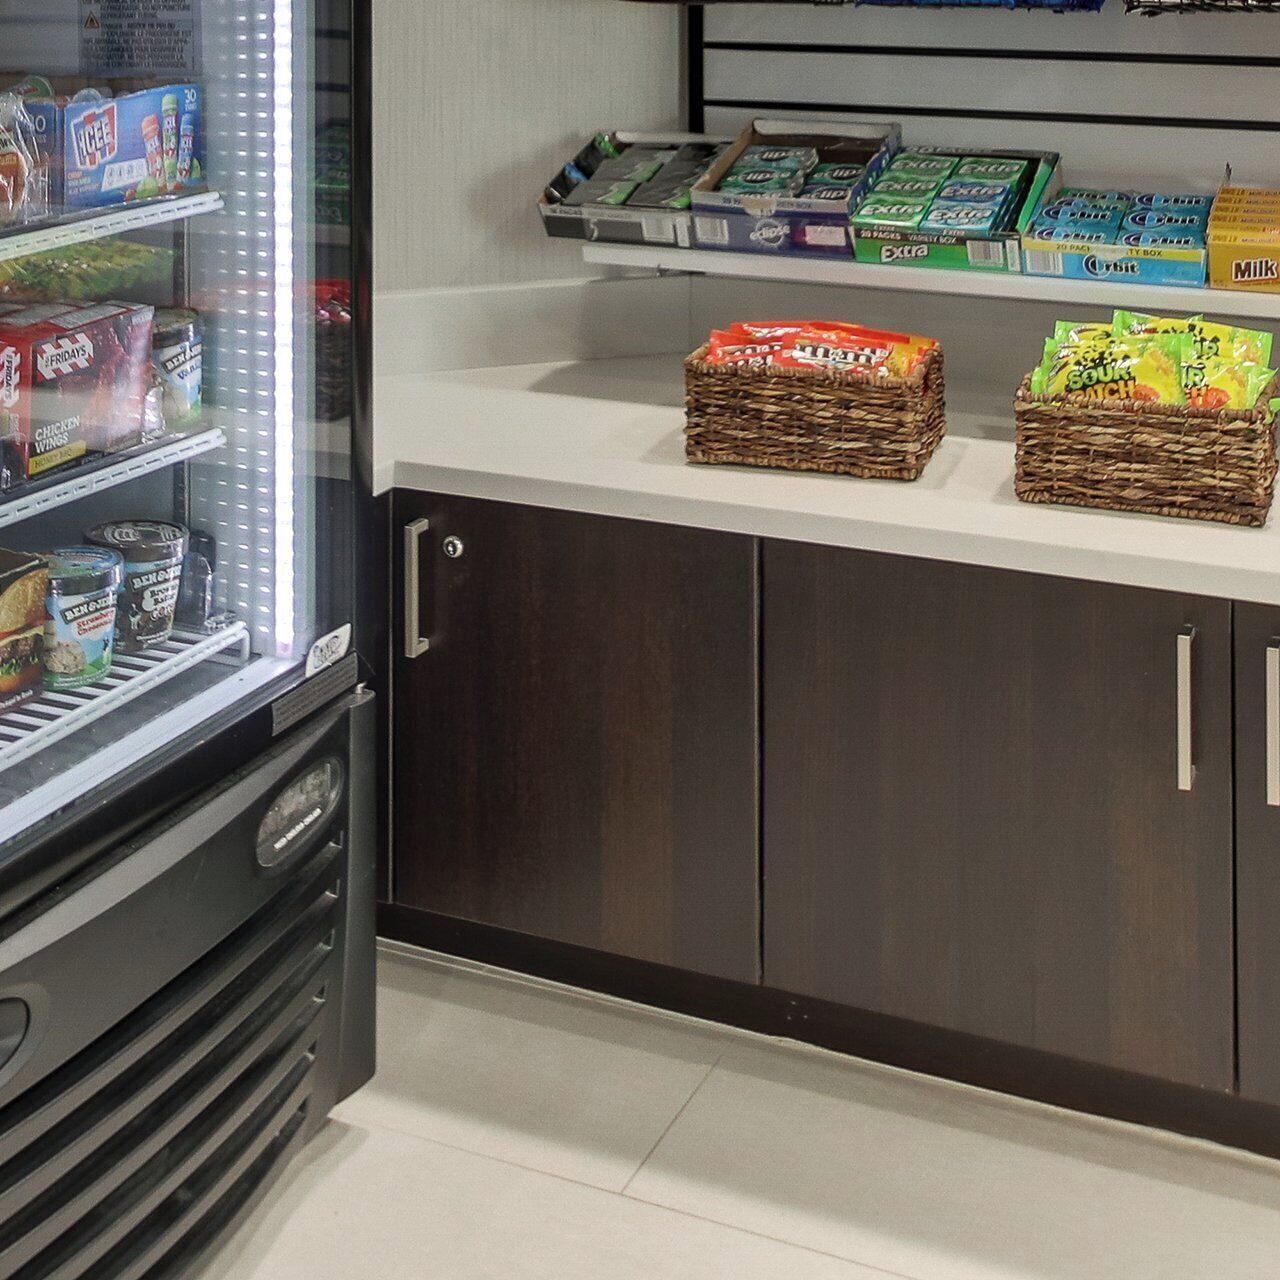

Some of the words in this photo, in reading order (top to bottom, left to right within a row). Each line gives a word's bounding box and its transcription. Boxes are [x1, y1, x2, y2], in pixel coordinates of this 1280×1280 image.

[184, 88, 197, 104] 30
[874, 180, 937, 191] Extra
[940, 185, 1004, 197] Extra
[859, 203, 924, 215] Extra
[926, 208, 993, 220] Extra
[750, 223, 791, 241] eclipse
[880, 243, 929, 263] Extra
[1142, 249, 1163, 257] BOX
[1082, 254, 1140, 279] Orbit
[1232, 257, 1276, 282] Milk
[50, 344, 87, 367] FRIDAYS
[5, 358, 15, 402] FRIDAYS
[1067, 366, 1131, 390] SOUR
[35, 416, 80, 441] CHICKEN
[35, 432, 70, 454] WINGS
